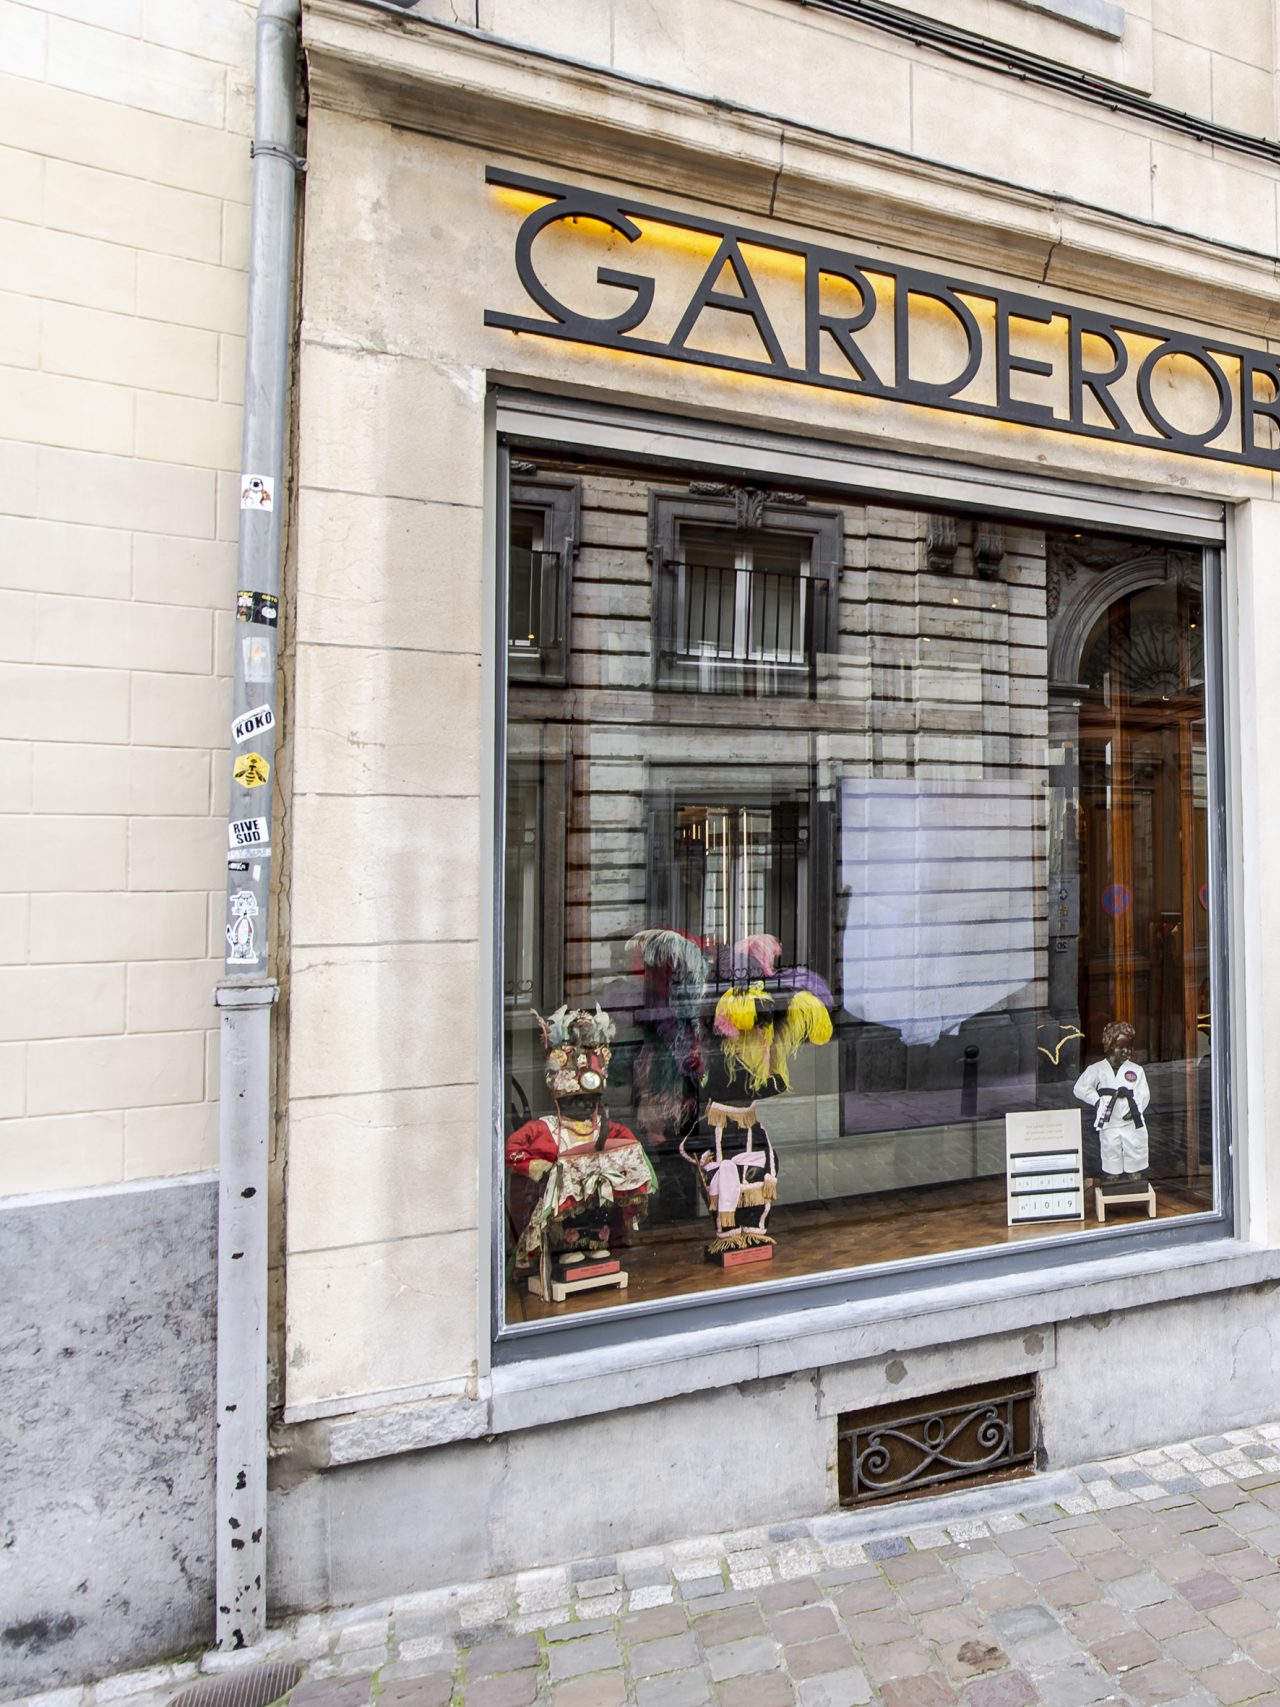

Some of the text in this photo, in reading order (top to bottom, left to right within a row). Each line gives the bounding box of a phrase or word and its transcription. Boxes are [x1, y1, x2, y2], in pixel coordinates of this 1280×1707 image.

[236, 711, 272, 738] KOKO
[233, 820, 260, 834] RIVE
[236, 831, 261, 845] SUD
